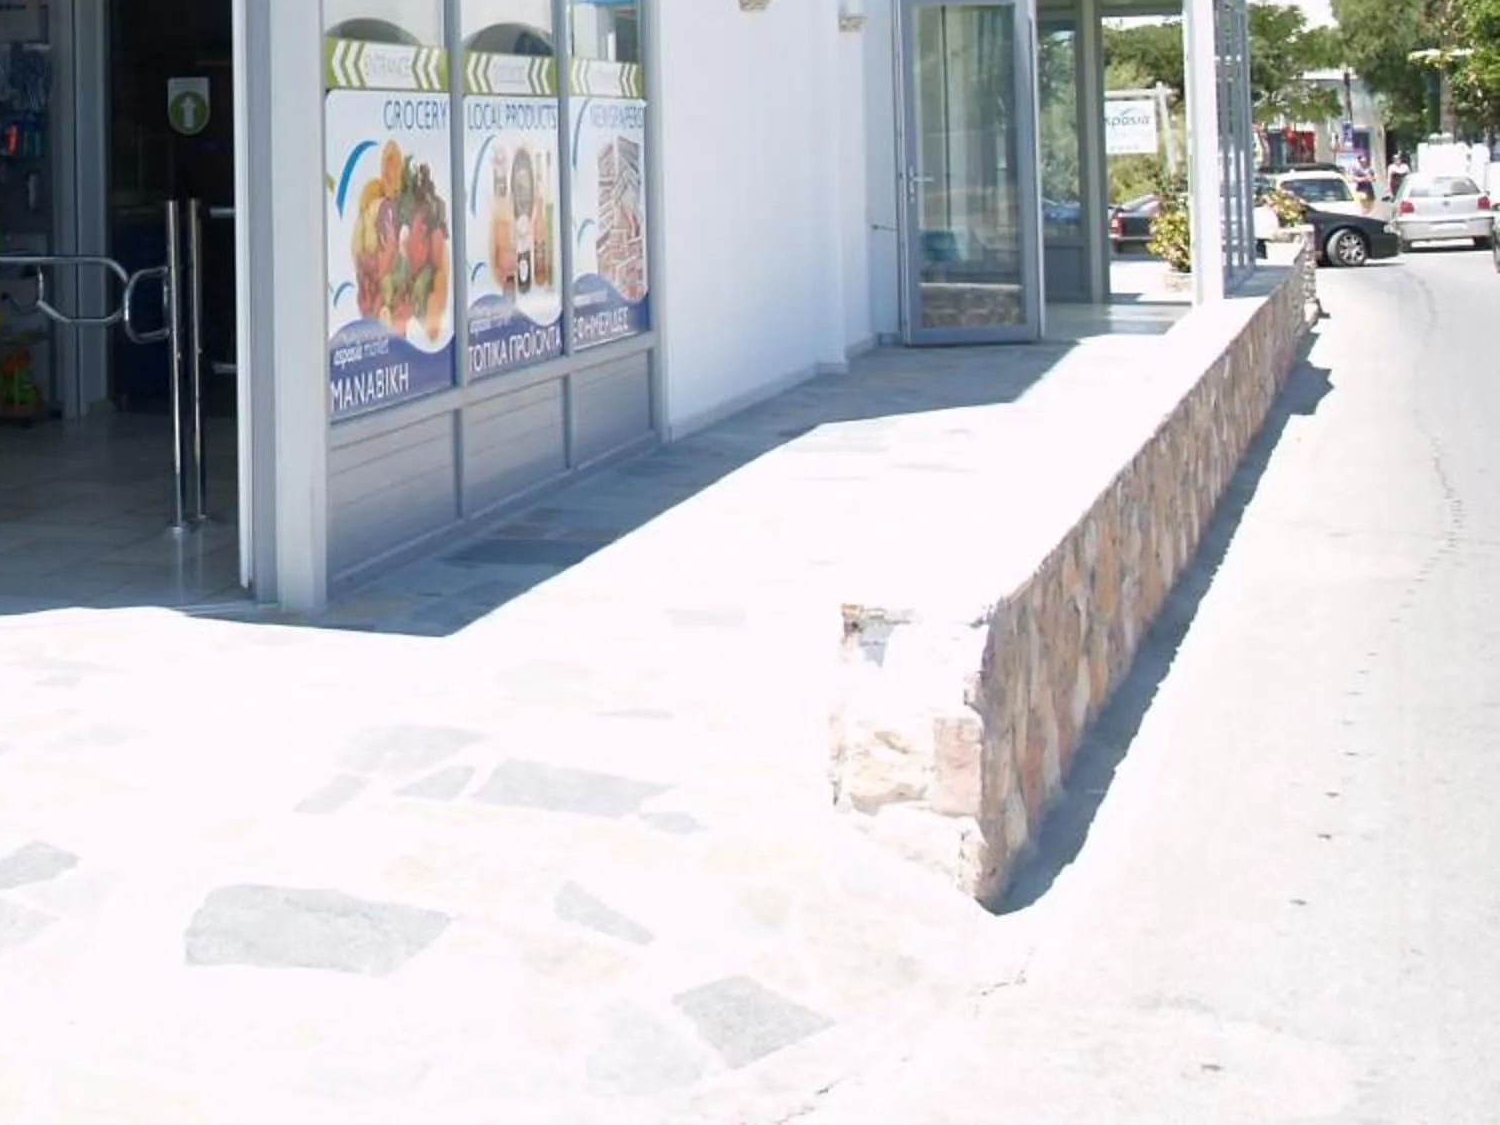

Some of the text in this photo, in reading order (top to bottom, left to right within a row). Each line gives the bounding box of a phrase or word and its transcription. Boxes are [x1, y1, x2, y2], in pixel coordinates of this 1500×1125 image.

[383, 99, 448, 131] GROCERY
[468, 101, 503, 130] LOCAL
[329, 363, 409, 412] ΜΑΝΑΒΙΚΗ
